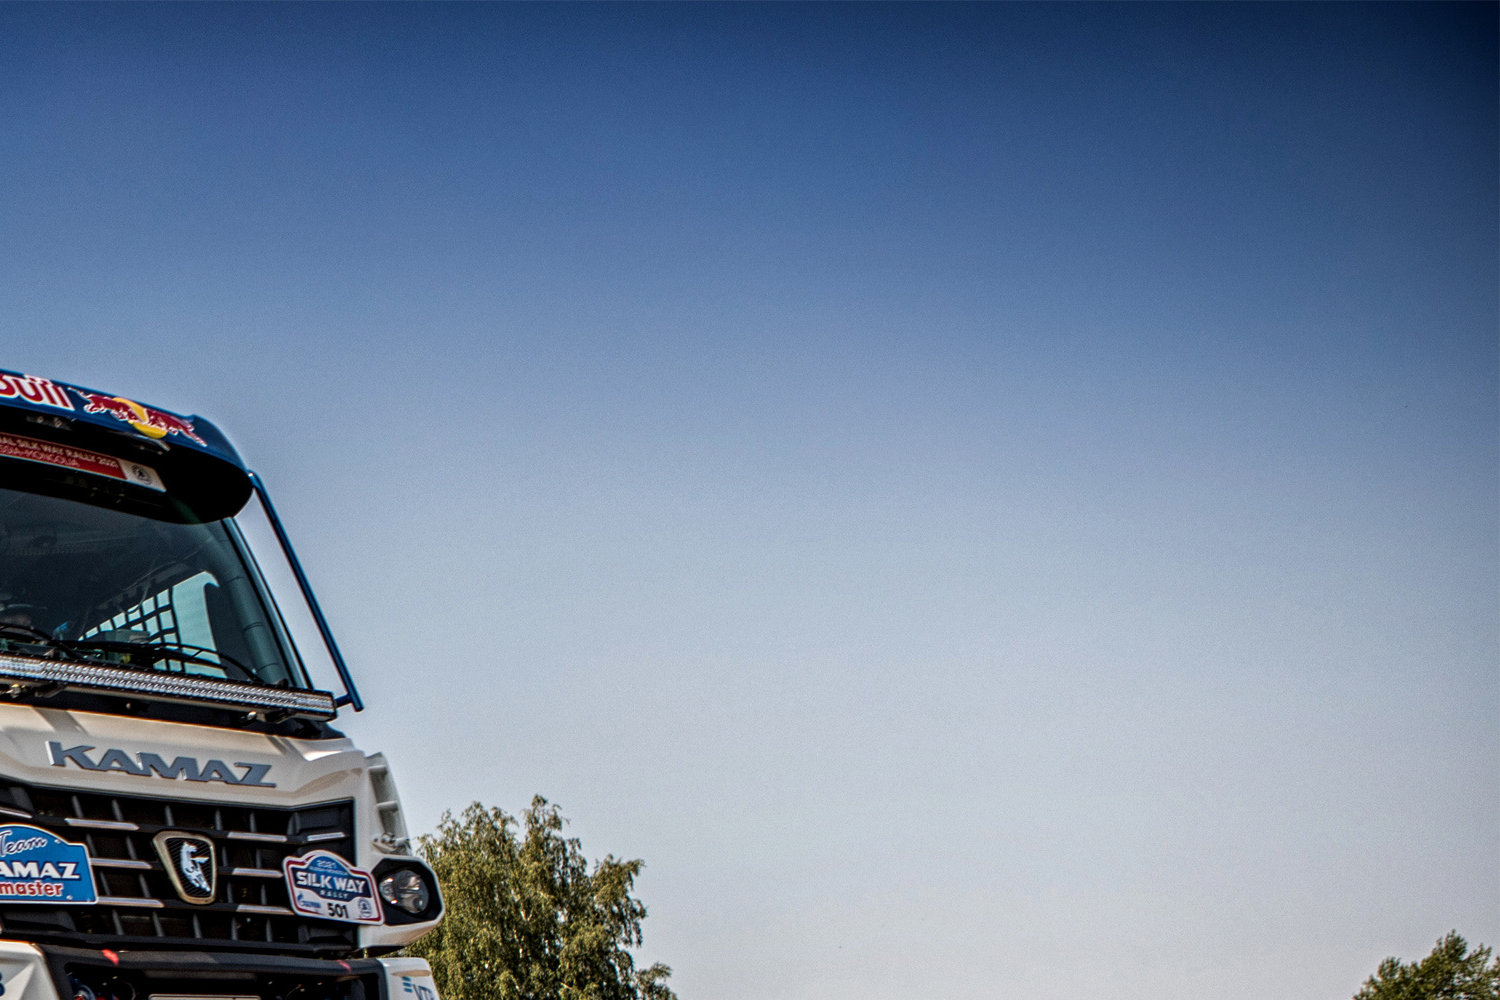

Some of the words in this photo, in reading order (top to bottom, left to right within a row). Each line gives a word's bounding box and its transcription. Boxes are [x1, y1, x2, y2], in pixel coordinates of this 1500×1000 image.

[17, 438, 39, 450] SILK
[45, 741, 276, 788] KAMAZ
[296, 871, 332, 889] SILK
[333, 877, 366, 893] WAY
[320, 890, 349, 899] RALLY
[327, 902, 349, 919] 501
